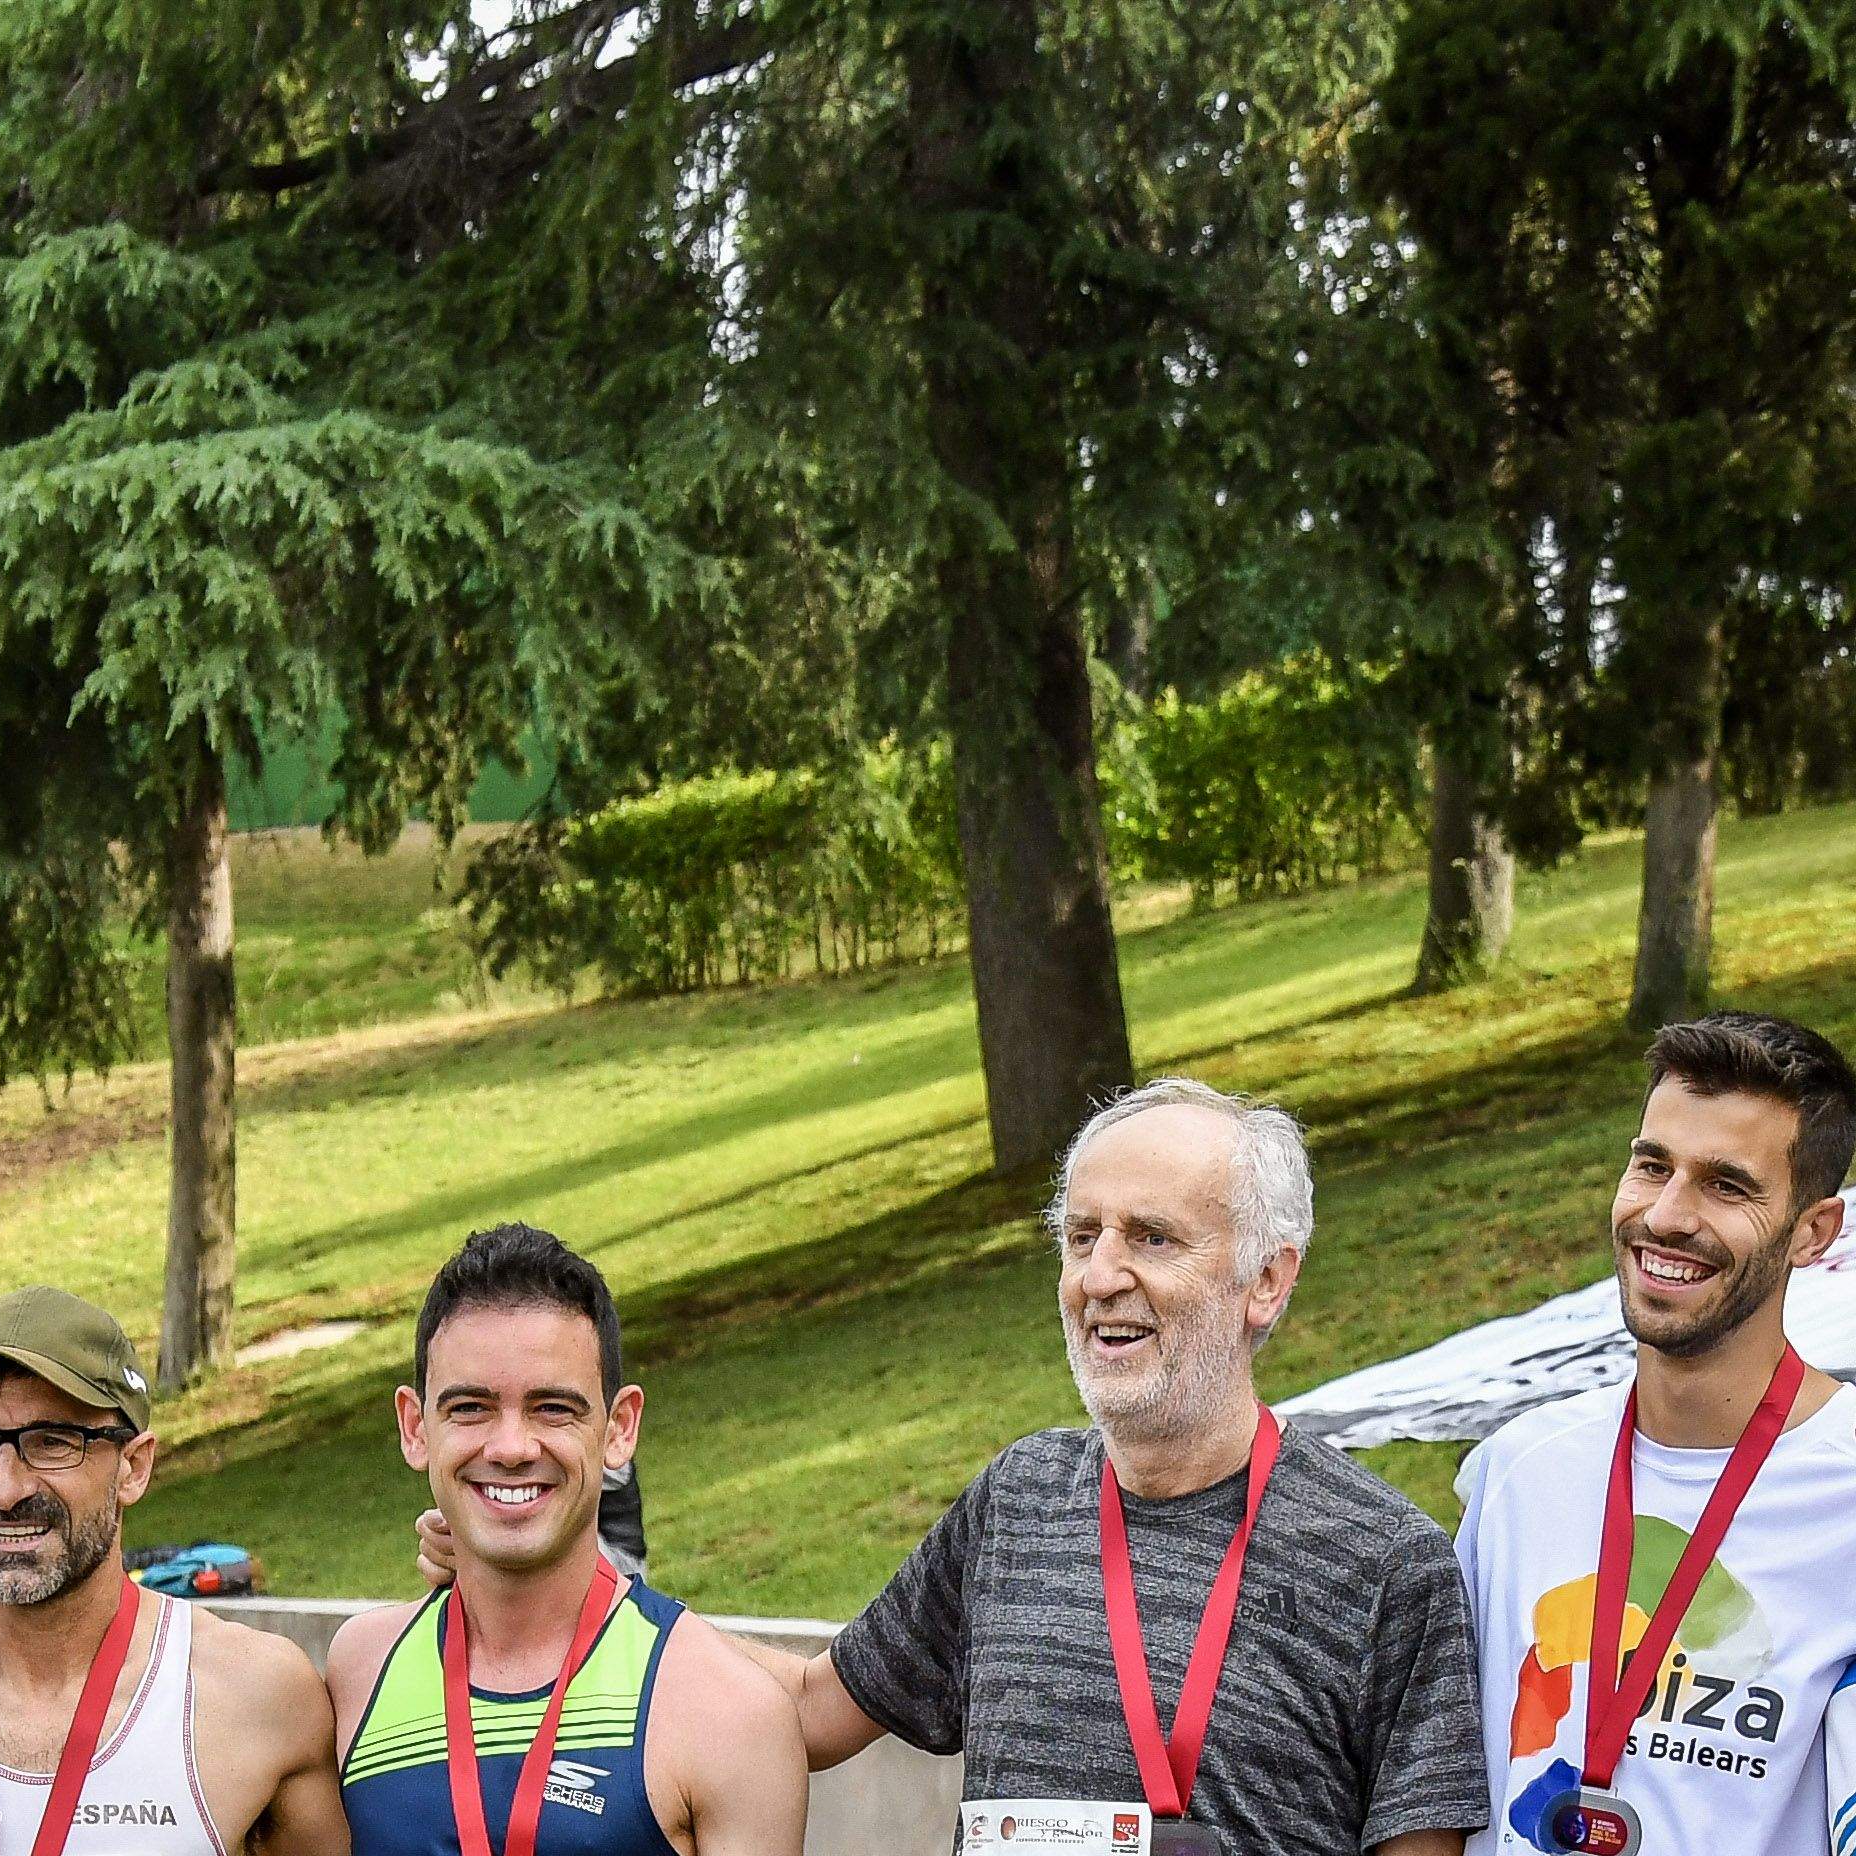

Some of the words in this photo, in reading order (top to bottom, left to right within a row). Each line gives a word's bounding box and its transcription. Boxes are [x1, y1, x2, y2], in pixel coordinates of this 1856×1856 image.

[1648, 1732, 1767, 1779] Balears
[544, 1783, 606, 1808] ECHERS
[72, 1799, 178, 1826] ESPAÑA
[1017, 1818, 1068, 1828] RIESGO
